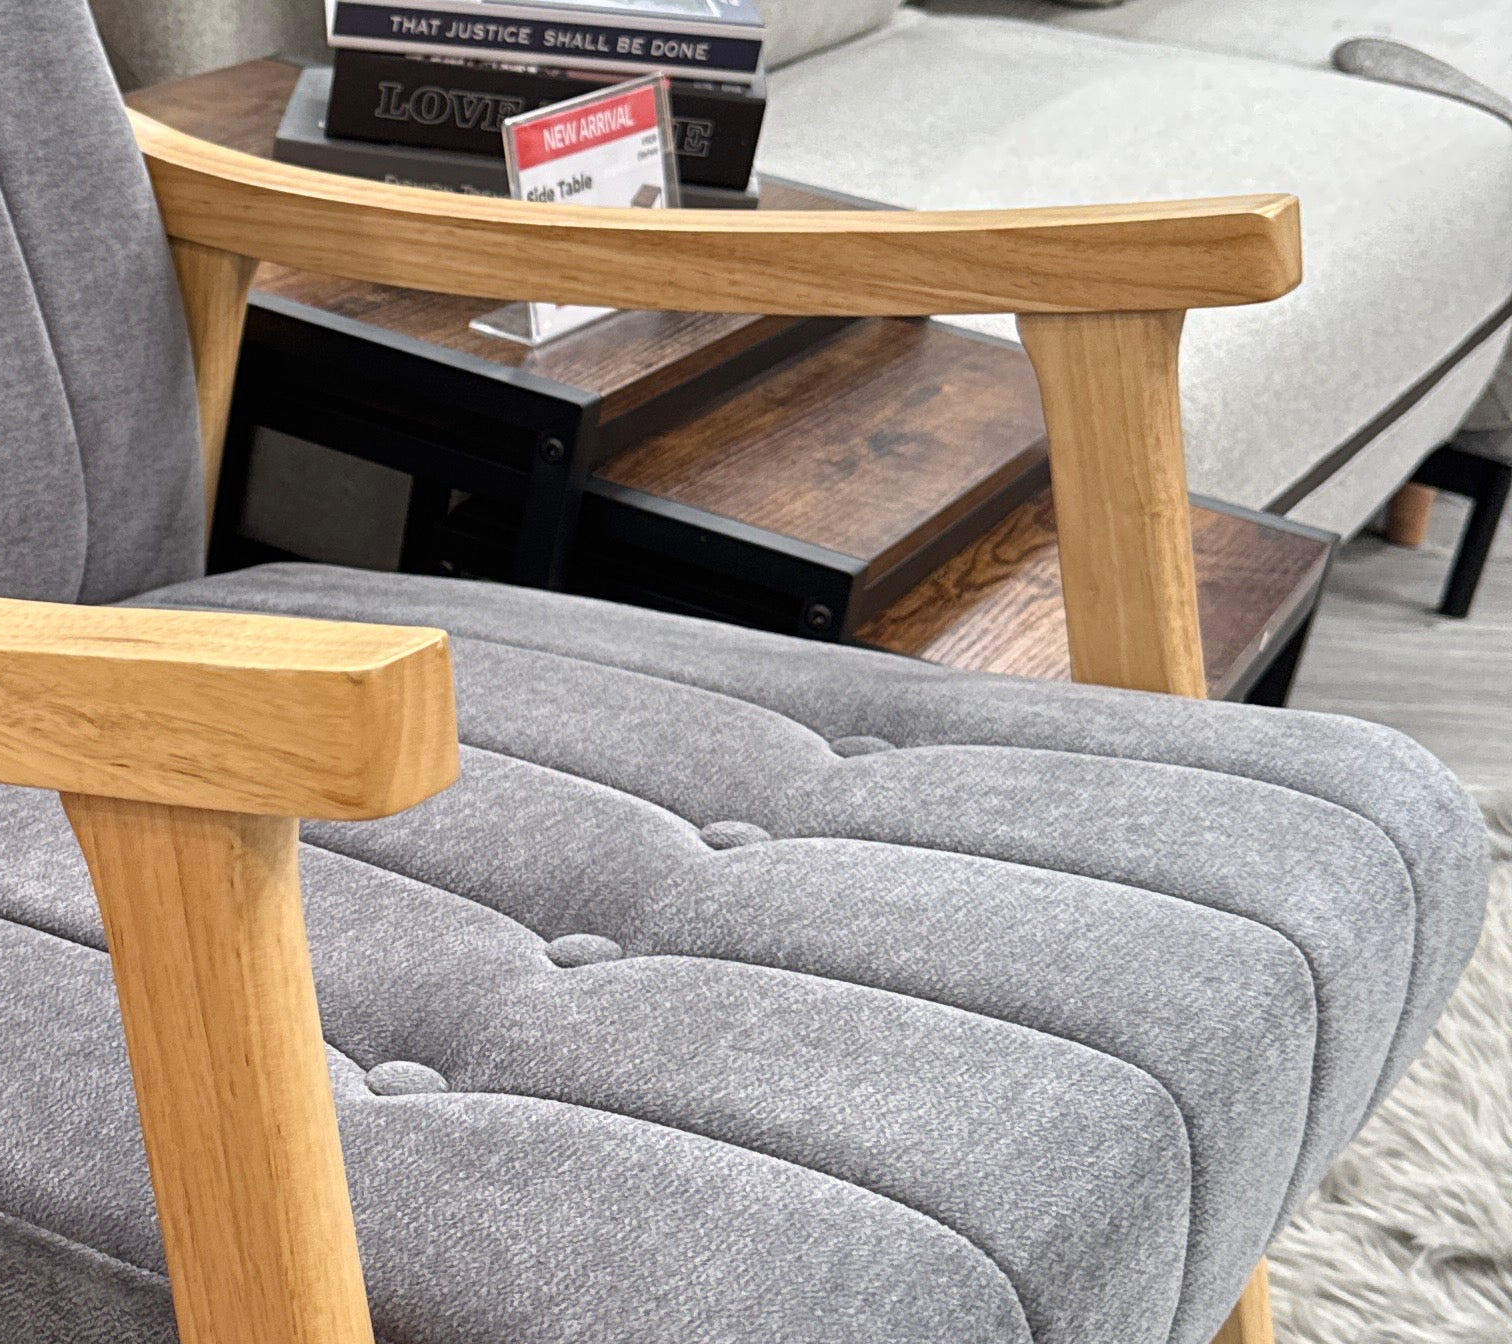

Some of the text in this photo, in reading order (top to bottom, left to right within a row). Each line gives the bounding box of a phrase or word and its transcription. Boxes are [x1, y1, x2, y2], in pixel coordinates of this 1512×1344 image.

[390, 14, 711, 61] THAT JUSTICE SHALL BE DONE
[374, 80, 525, 132] LOVE
[542, 118, 578, 152] NEW
[579, 103, 636, 142] ARRIVAL
[526, 186, 555, 202] Side
[557, 173, 593, 199] Table
